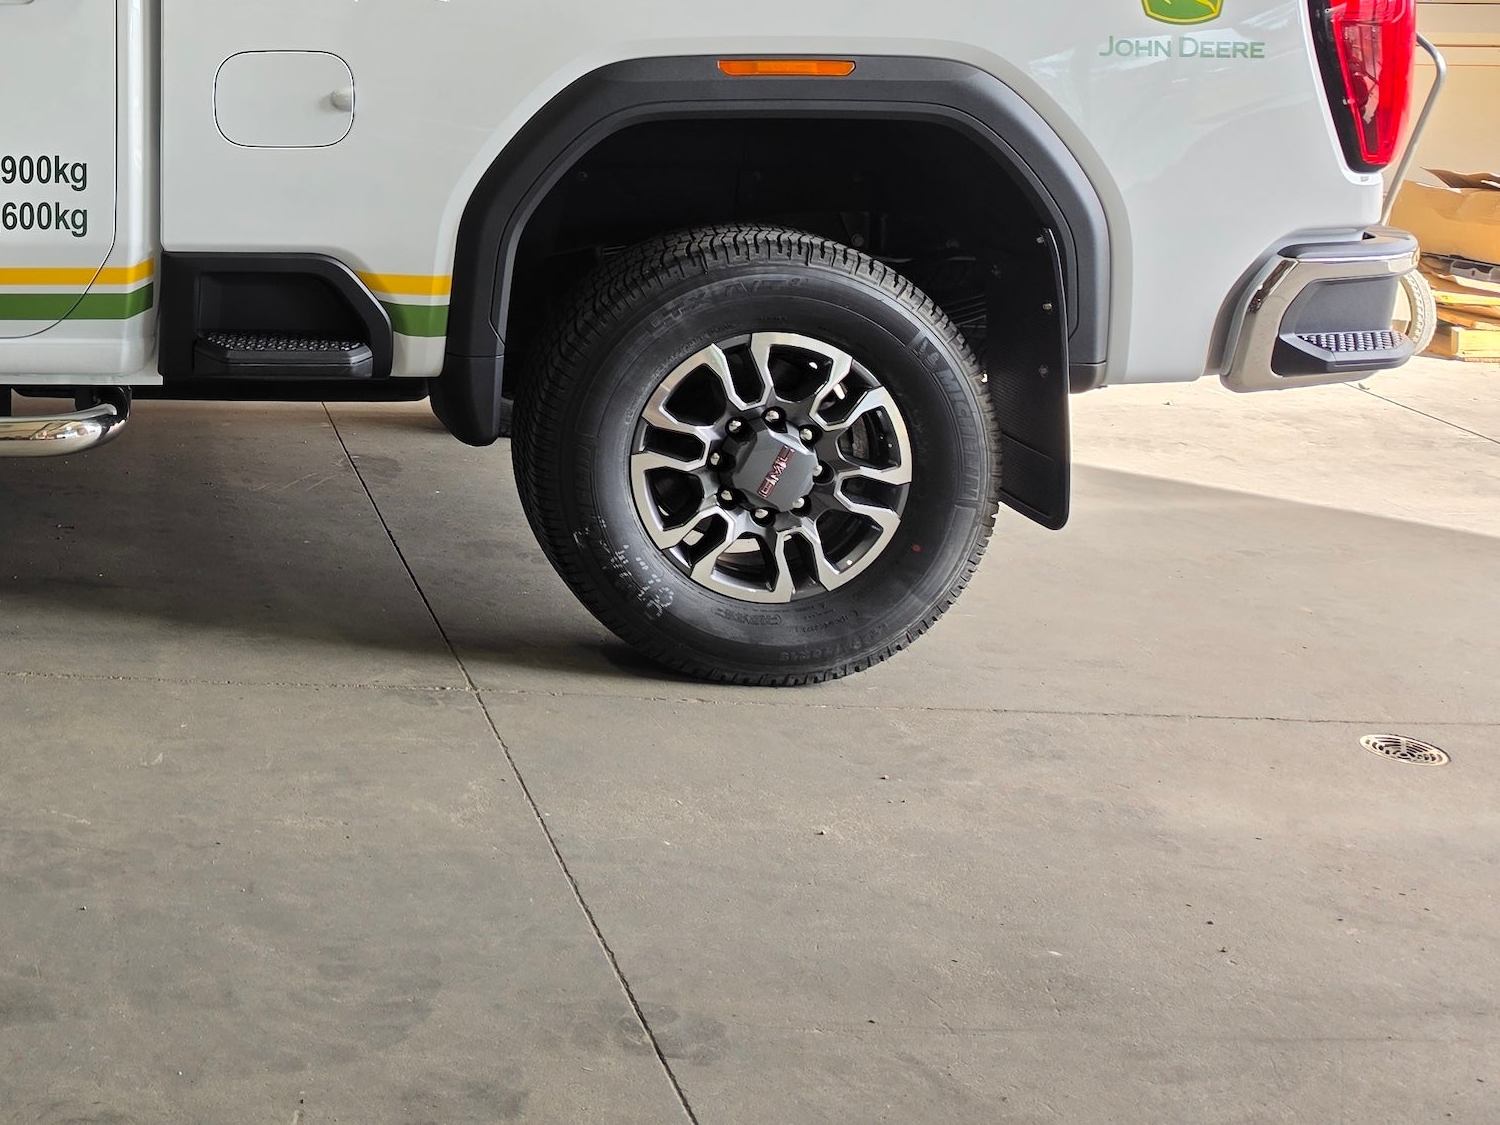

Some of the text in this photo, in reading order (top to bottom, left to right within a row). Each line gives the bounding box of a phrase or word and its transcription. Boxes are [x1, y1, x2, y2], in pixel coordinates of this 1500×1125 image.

[1099, 35, 1266, 59] JOHN DEERE
[757, 445, 795, 498] GMC
